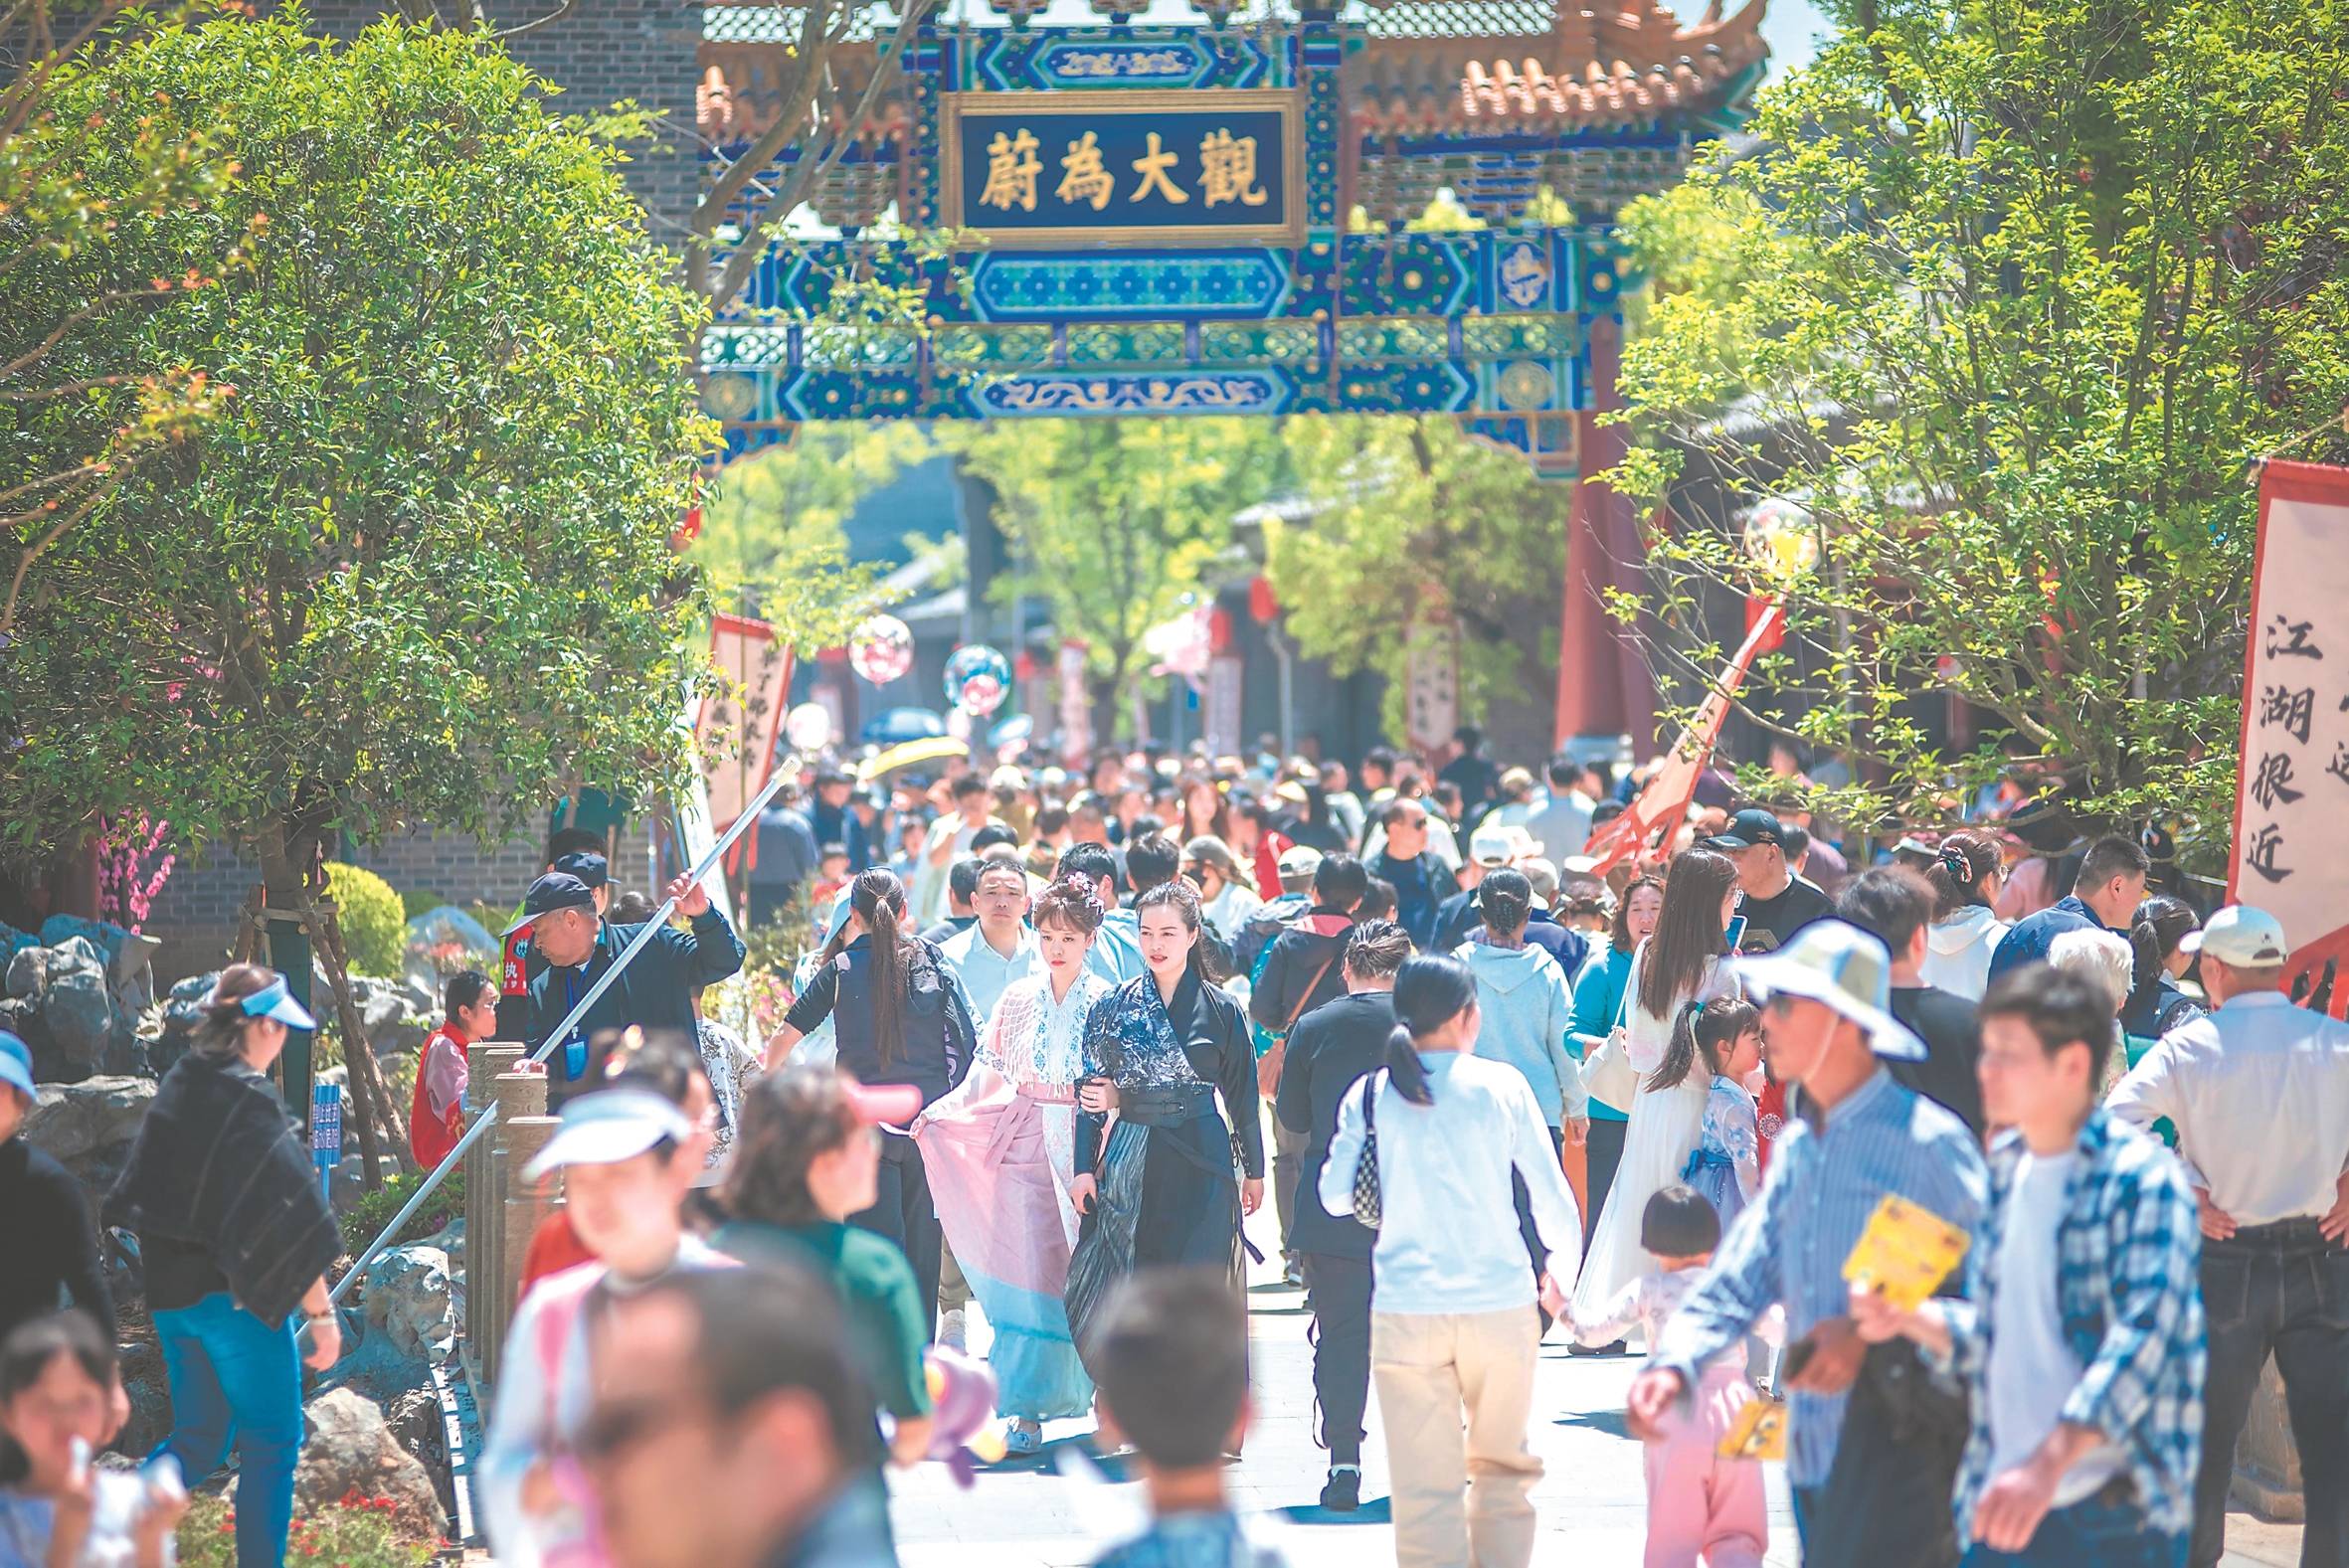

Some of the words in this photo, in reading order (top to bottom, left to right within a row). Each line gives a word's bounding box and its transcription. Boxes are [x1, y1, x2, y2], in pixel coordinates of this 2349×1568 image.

[979, 127, 1268, 211] 蔚為大觀
[2246, 614, 2324, 884] 江湖很近
